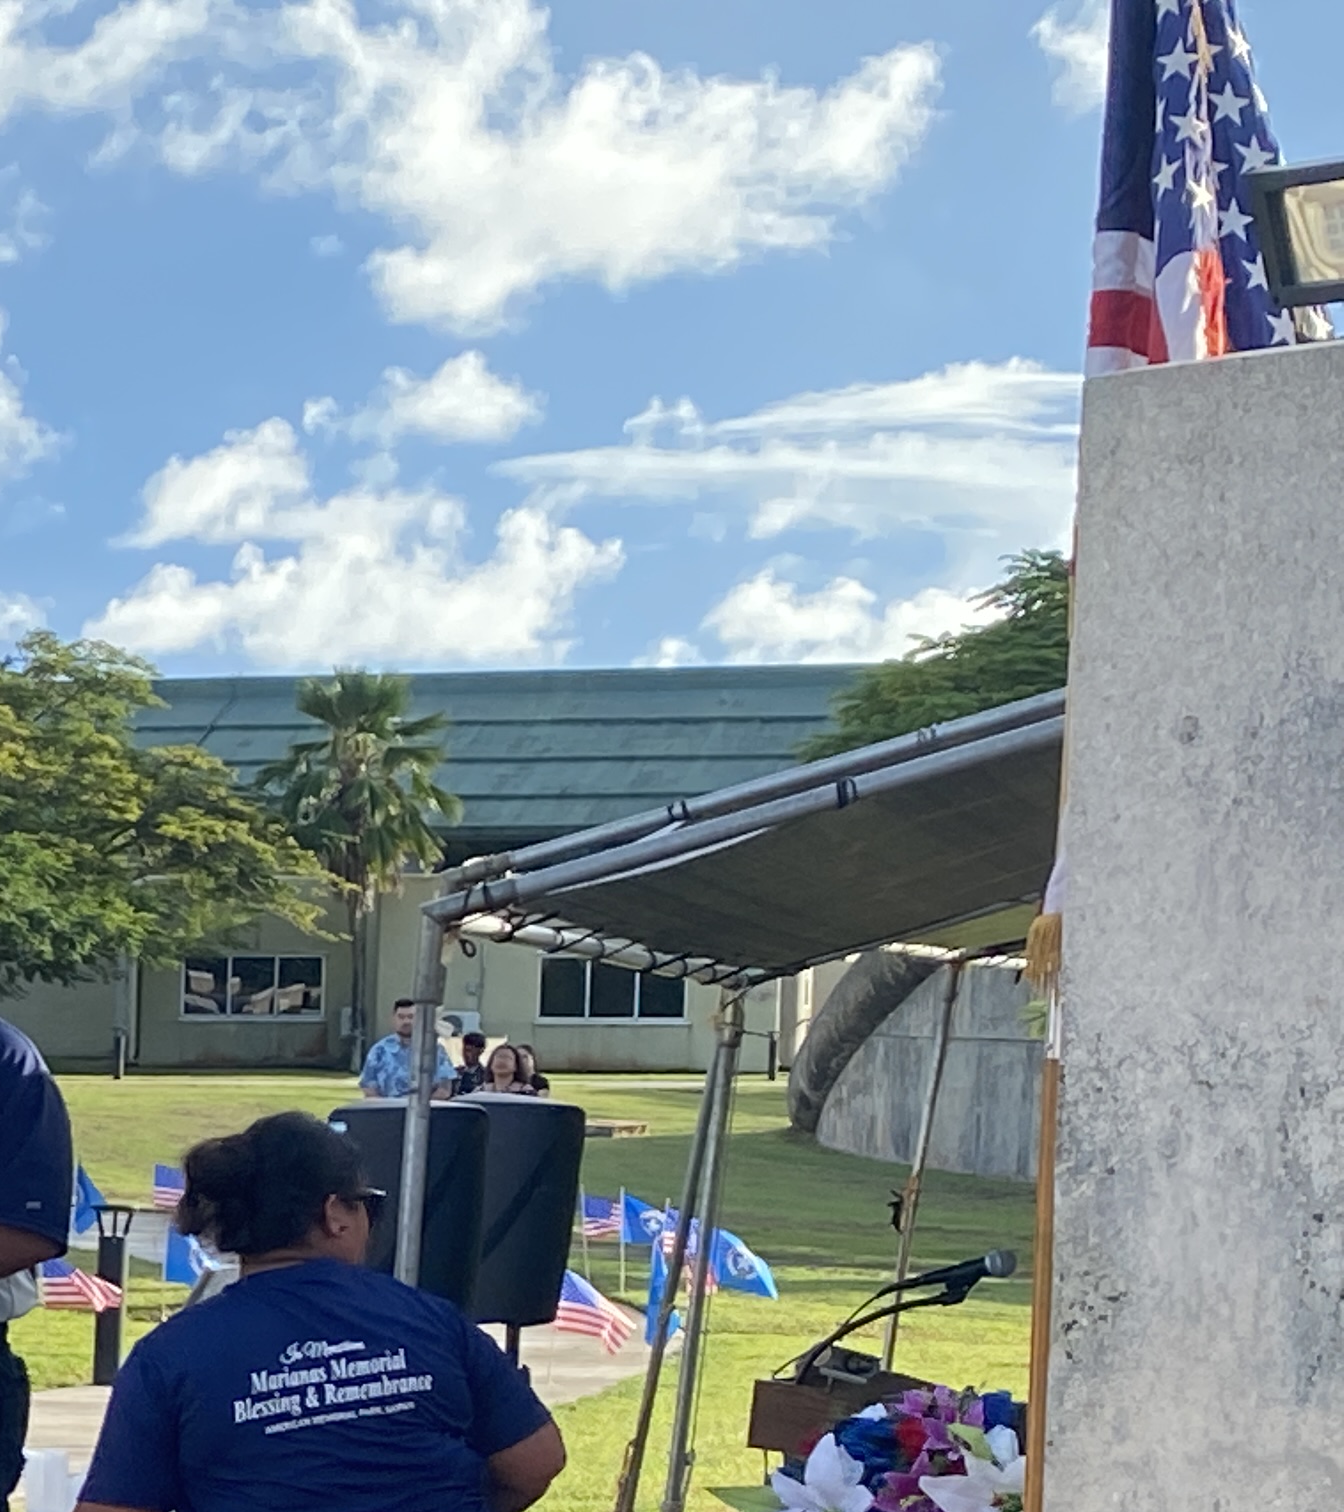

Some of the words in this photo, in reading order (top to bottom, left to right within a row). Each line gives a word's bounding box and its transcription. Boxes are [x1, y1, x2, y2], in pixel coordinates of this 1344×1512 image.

[251, 1366, 327, 1395] Marianas
[330, 1348, 406, 1380] Memorial
[233, 1391, 302, 1423] Blessing
[305, 1385, 320, 1408] &
[324, 1374, 433, 1405] Remembrance
